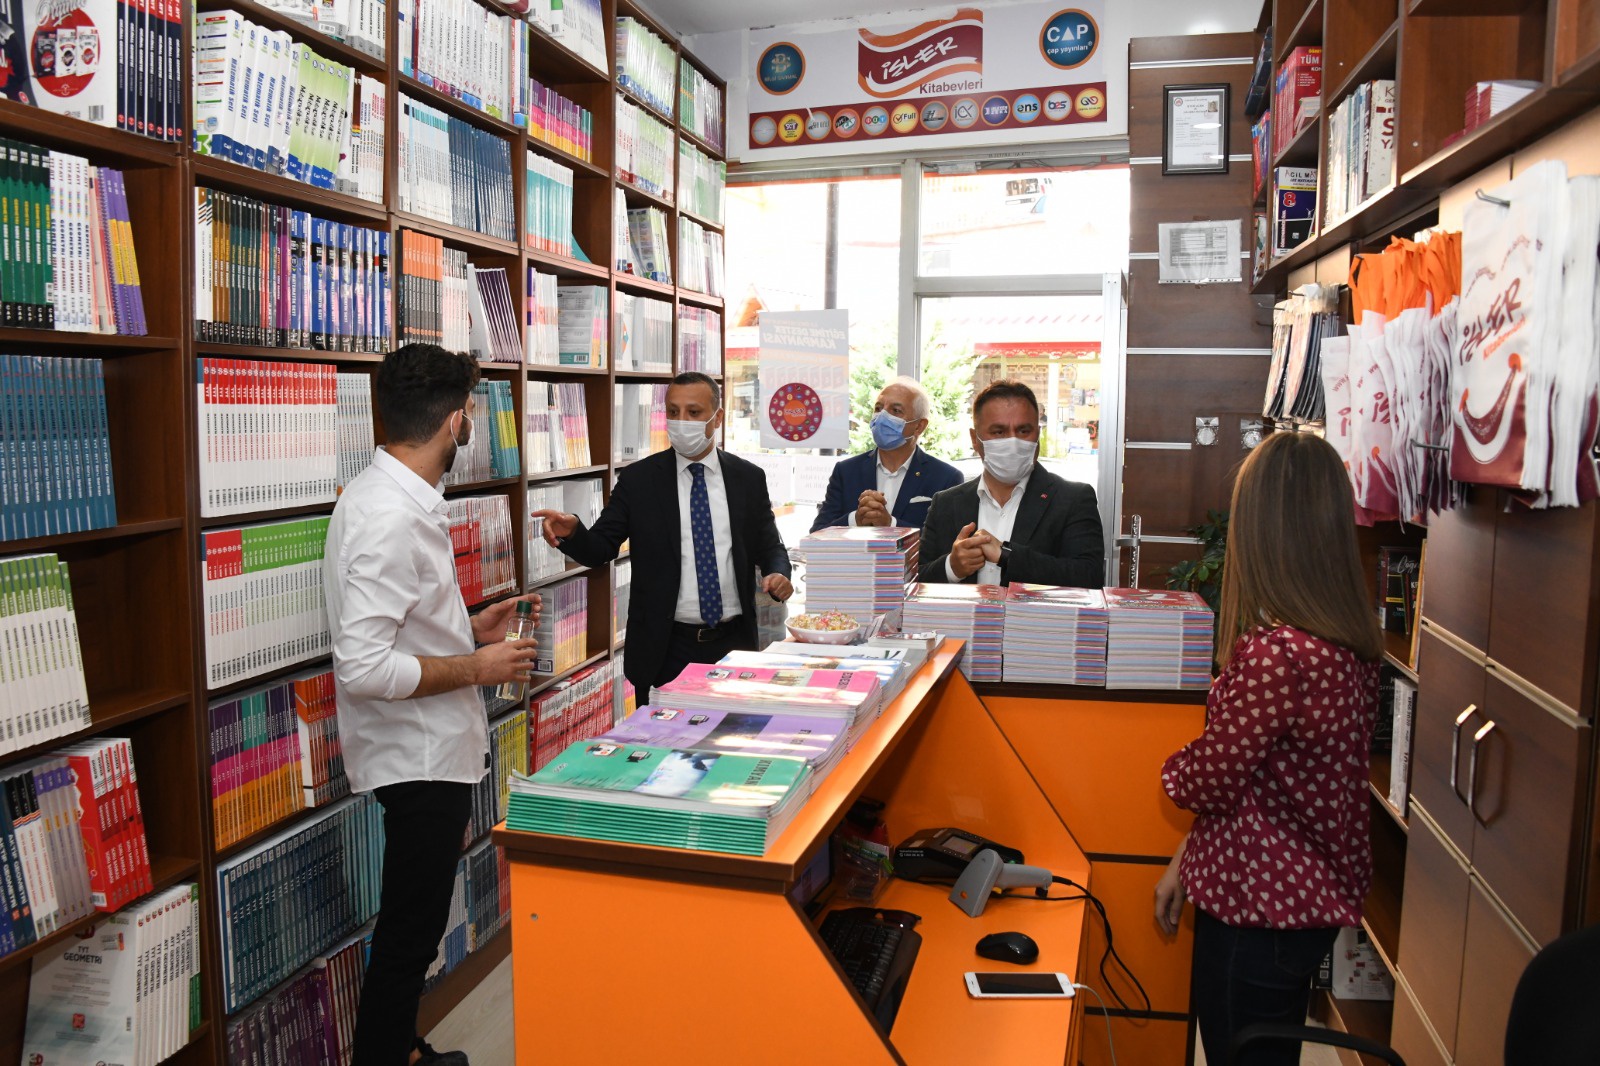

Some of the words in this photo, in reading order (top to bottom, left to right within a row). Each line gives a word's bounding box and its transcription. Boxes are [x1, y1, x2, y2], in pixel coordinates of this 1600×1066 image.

[1301, 55, 1319, 64] TÜM
[229, 58, 237, 98] Matematik
[243, 67, 252, 106] Matematik
[255, 72, 264, 108] Matematik
[267, 77, 276, 112] Matematik
[920, 78, 983, 94] Kitabevleri
[1017, 102, 1038, 112] ens
[1283, 192, 1296, 207] 8
[4, 864, 17, 908] GEOMETRİ
[14, 860, 27, 904] GEOMETRİ
[64, 953, 102, 964] GEOMETRİ
